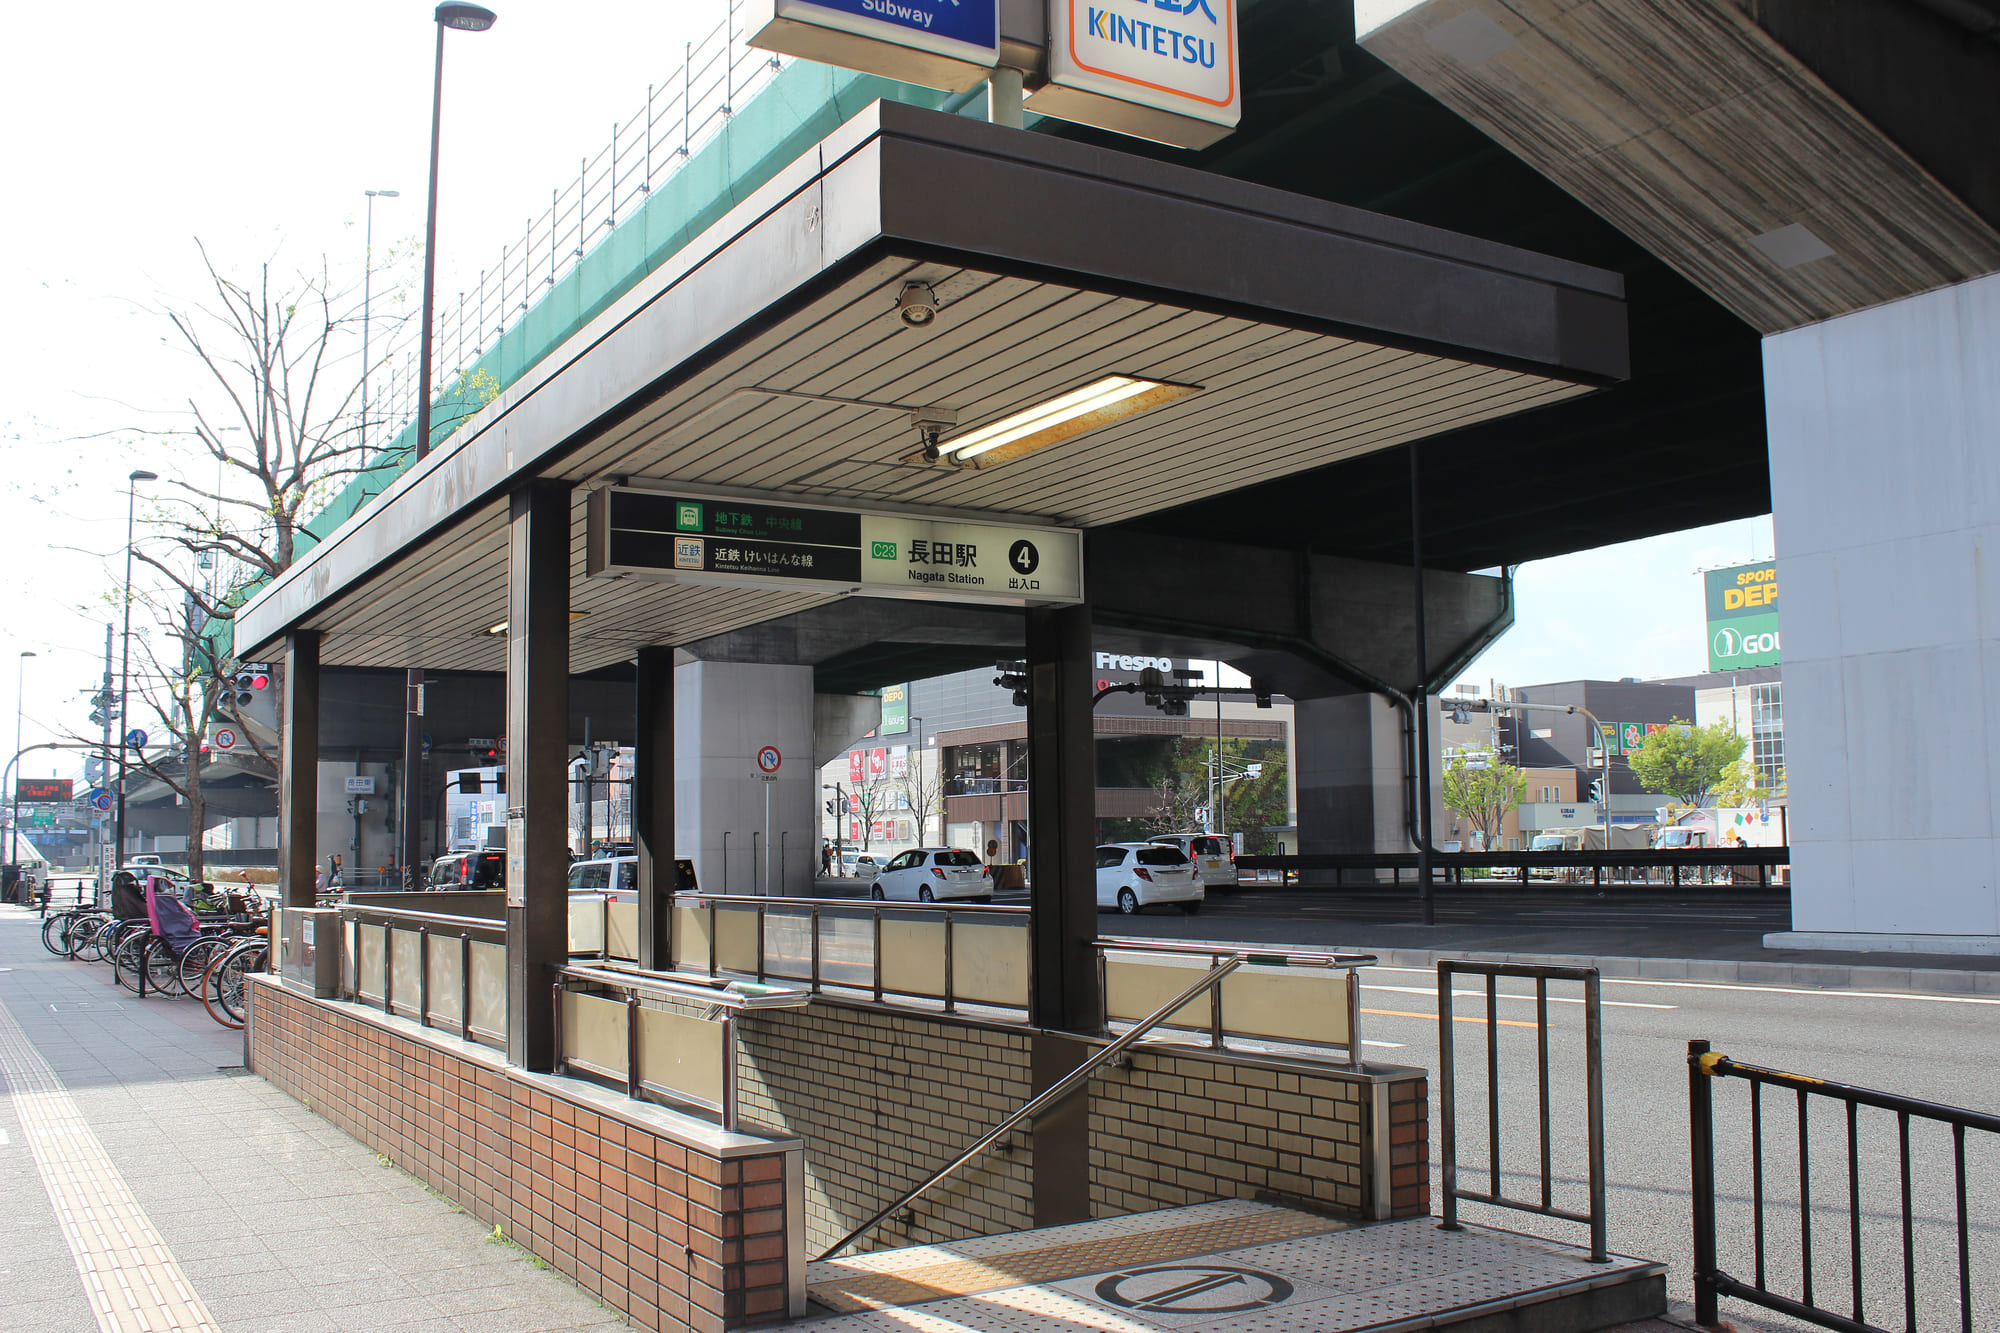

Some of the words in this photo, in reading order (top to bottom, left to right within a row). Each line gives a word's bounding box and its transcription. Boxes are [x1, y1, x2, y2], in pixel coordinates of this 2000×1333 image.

[862, 0, 934, 27] Subway
[1088, 6, 1215, 69] KINTETSU
[715, 511, 753, 527] 地下鉄
[765, 516, 803, 531] 中央線
[678, 543, 701, 556] 近鉄
[715, 548, 741, 562] 近鉄
[744, 550, 814, 567] けいはんな線
[872, 543, 896, 559] C23
[908, 539, 977, 568] 長田駅
[1016, 546, 1031, 569] 4
[715, 563, 739, 571] Kintetsu
[908, 569, 945, 583] Nagata
[948, 572, 985, 585] Station
[1008, 578, 1040, 590] 出入口
[1736, 568, 1776, 585] SPOR
[883, 691, 904, 703] DEPO
